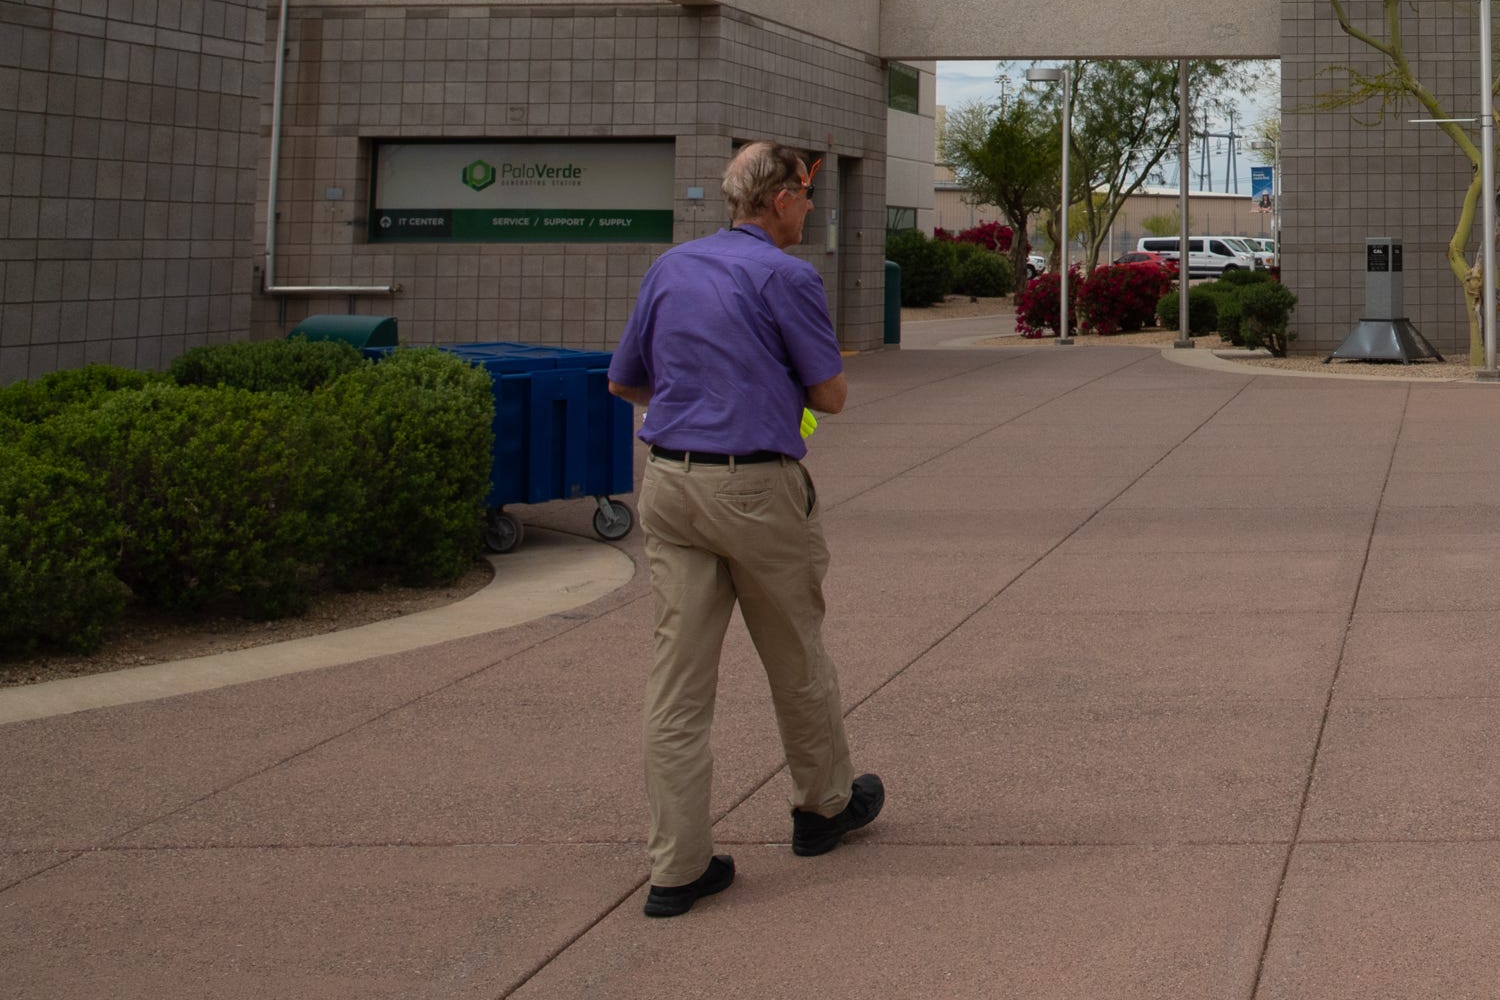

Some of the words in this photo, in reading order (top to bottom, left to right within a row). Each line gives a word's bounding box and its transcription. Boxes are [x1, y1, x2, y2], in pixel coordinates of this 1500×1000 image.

[502, 163, 582, 179] PaloVerde
[398, 218, 407, 226] IT
[409, 218, 444, 226] CENTER
[492, 218, 529, 226] SERVICE
[544, 218, 584, 226] SUPPORT
[599, 218, 632, 226] SUPPLY
